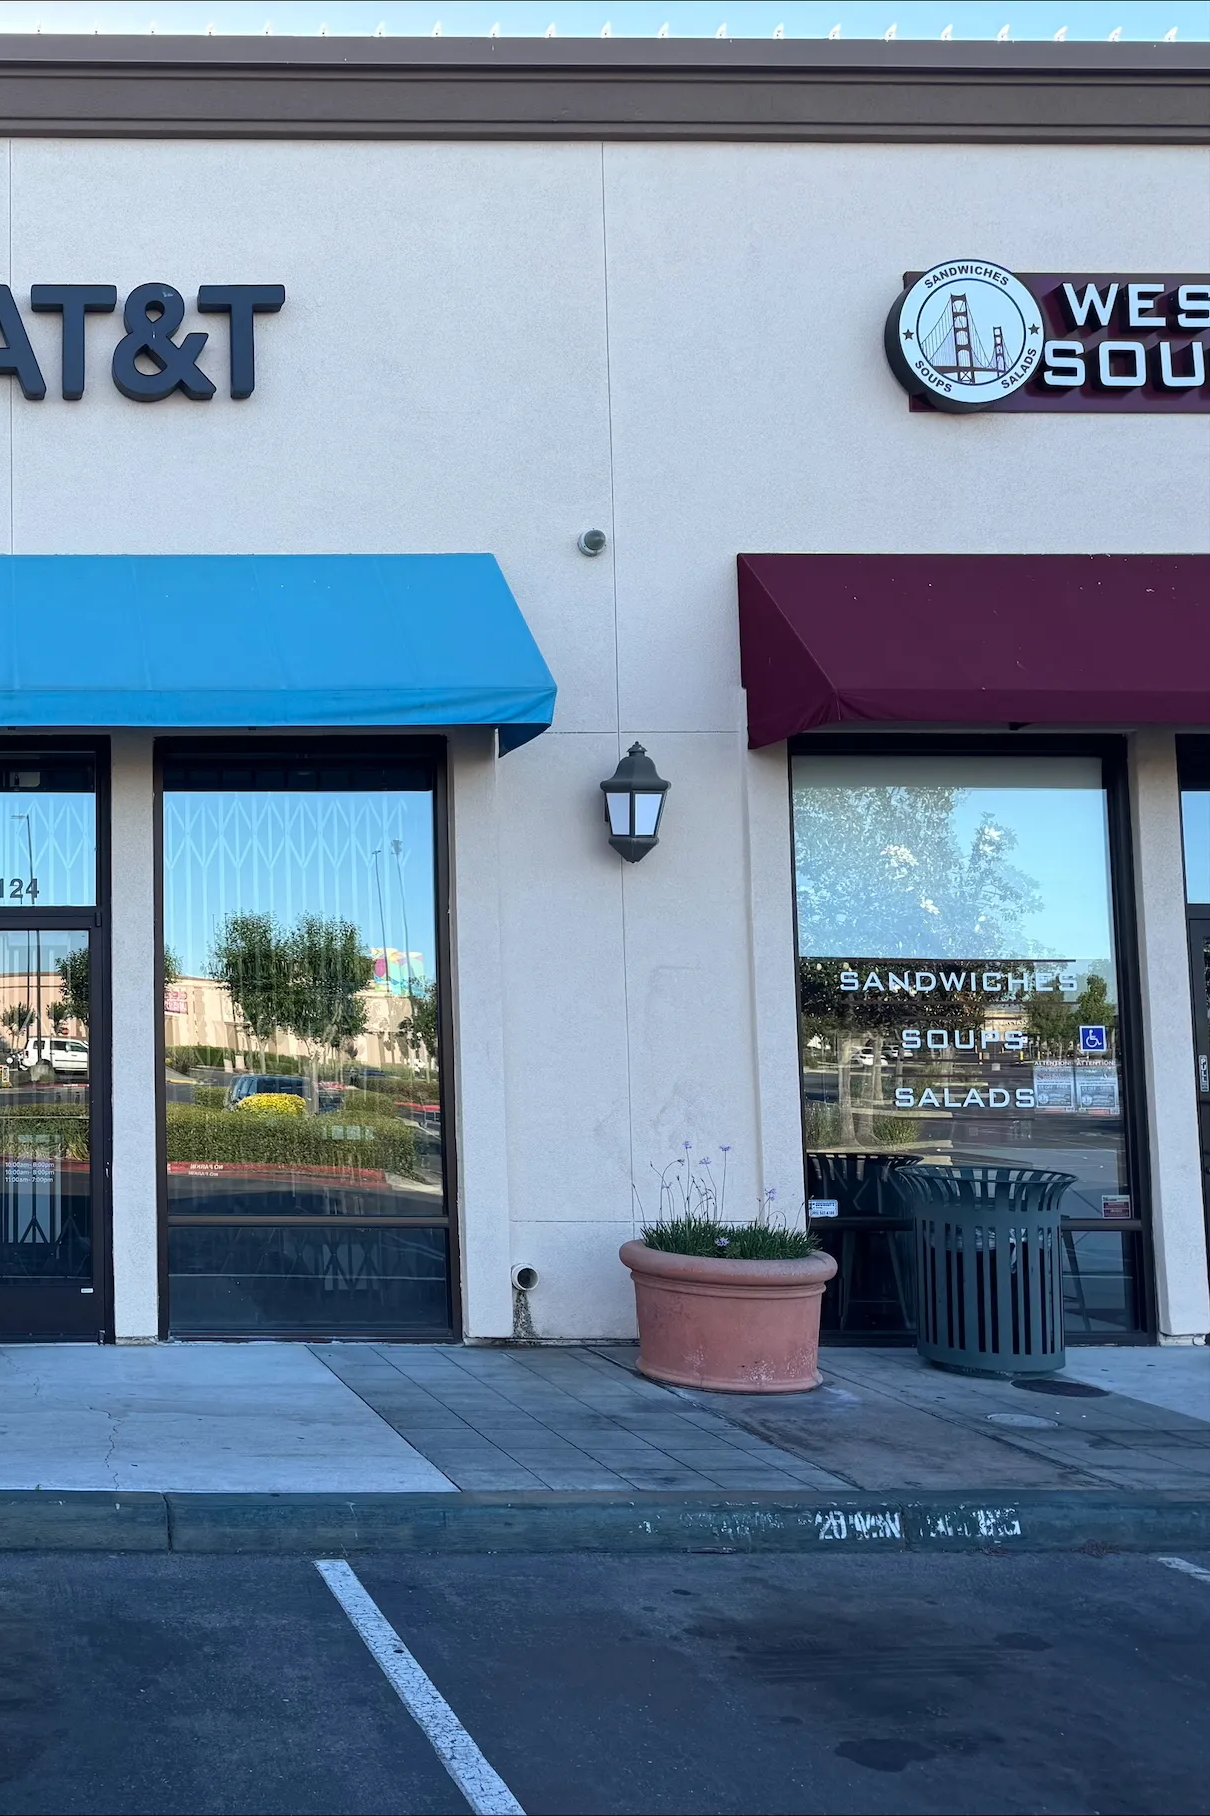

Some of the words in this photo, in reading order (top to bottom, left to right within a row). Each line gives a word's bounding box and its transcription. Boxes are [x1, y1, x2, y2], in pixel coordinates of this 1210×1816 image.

[924, 264, 1010, 289] SANDWICHES
[1062, 282, 1210, 328] WES
[914, 359, 953, 393] SOUPS
[1000, 347, 1037, 389] SALADS
[1043, 339, 1206, 388] SOU
[839, 971, 1078, 992] SANDWICHES
[902, 1029, 1024, 1050] SOUPS
[1200, 1058, 1208, 1083] PULL
[894, 1087, 1035, 1108] SALADS
